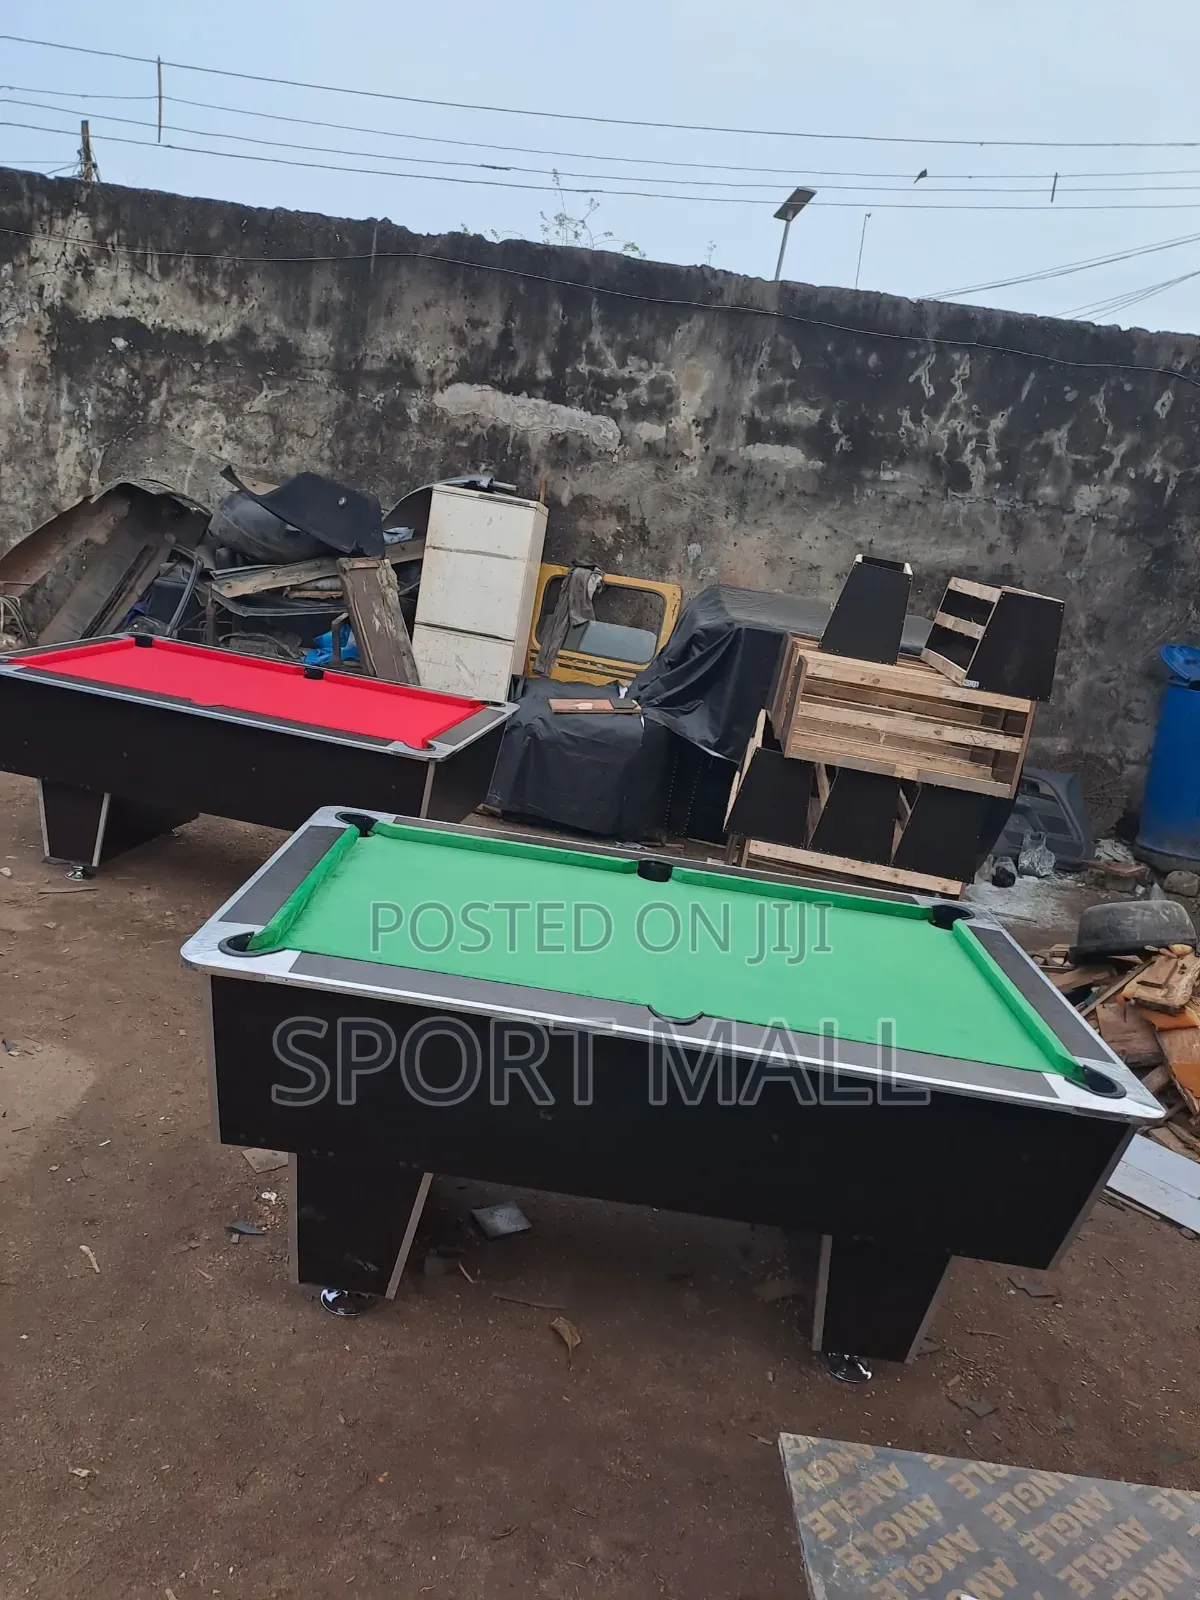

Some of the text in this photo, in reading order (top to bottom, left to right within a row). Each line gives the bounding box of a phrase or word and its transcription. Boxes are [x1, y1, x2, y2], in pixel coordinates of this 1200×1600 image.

[796, 1443, 876, 1493] ANGL
[801, 1462, 909, 1541] ANGLE
[944, 1461, 1010, 1500] GLE
[835, 1493, 943, 1576] ANGLE
[1018, 1486, 1114, 1564] ANGLE
[1055, 1514, 1152, 1598] ANGLE
